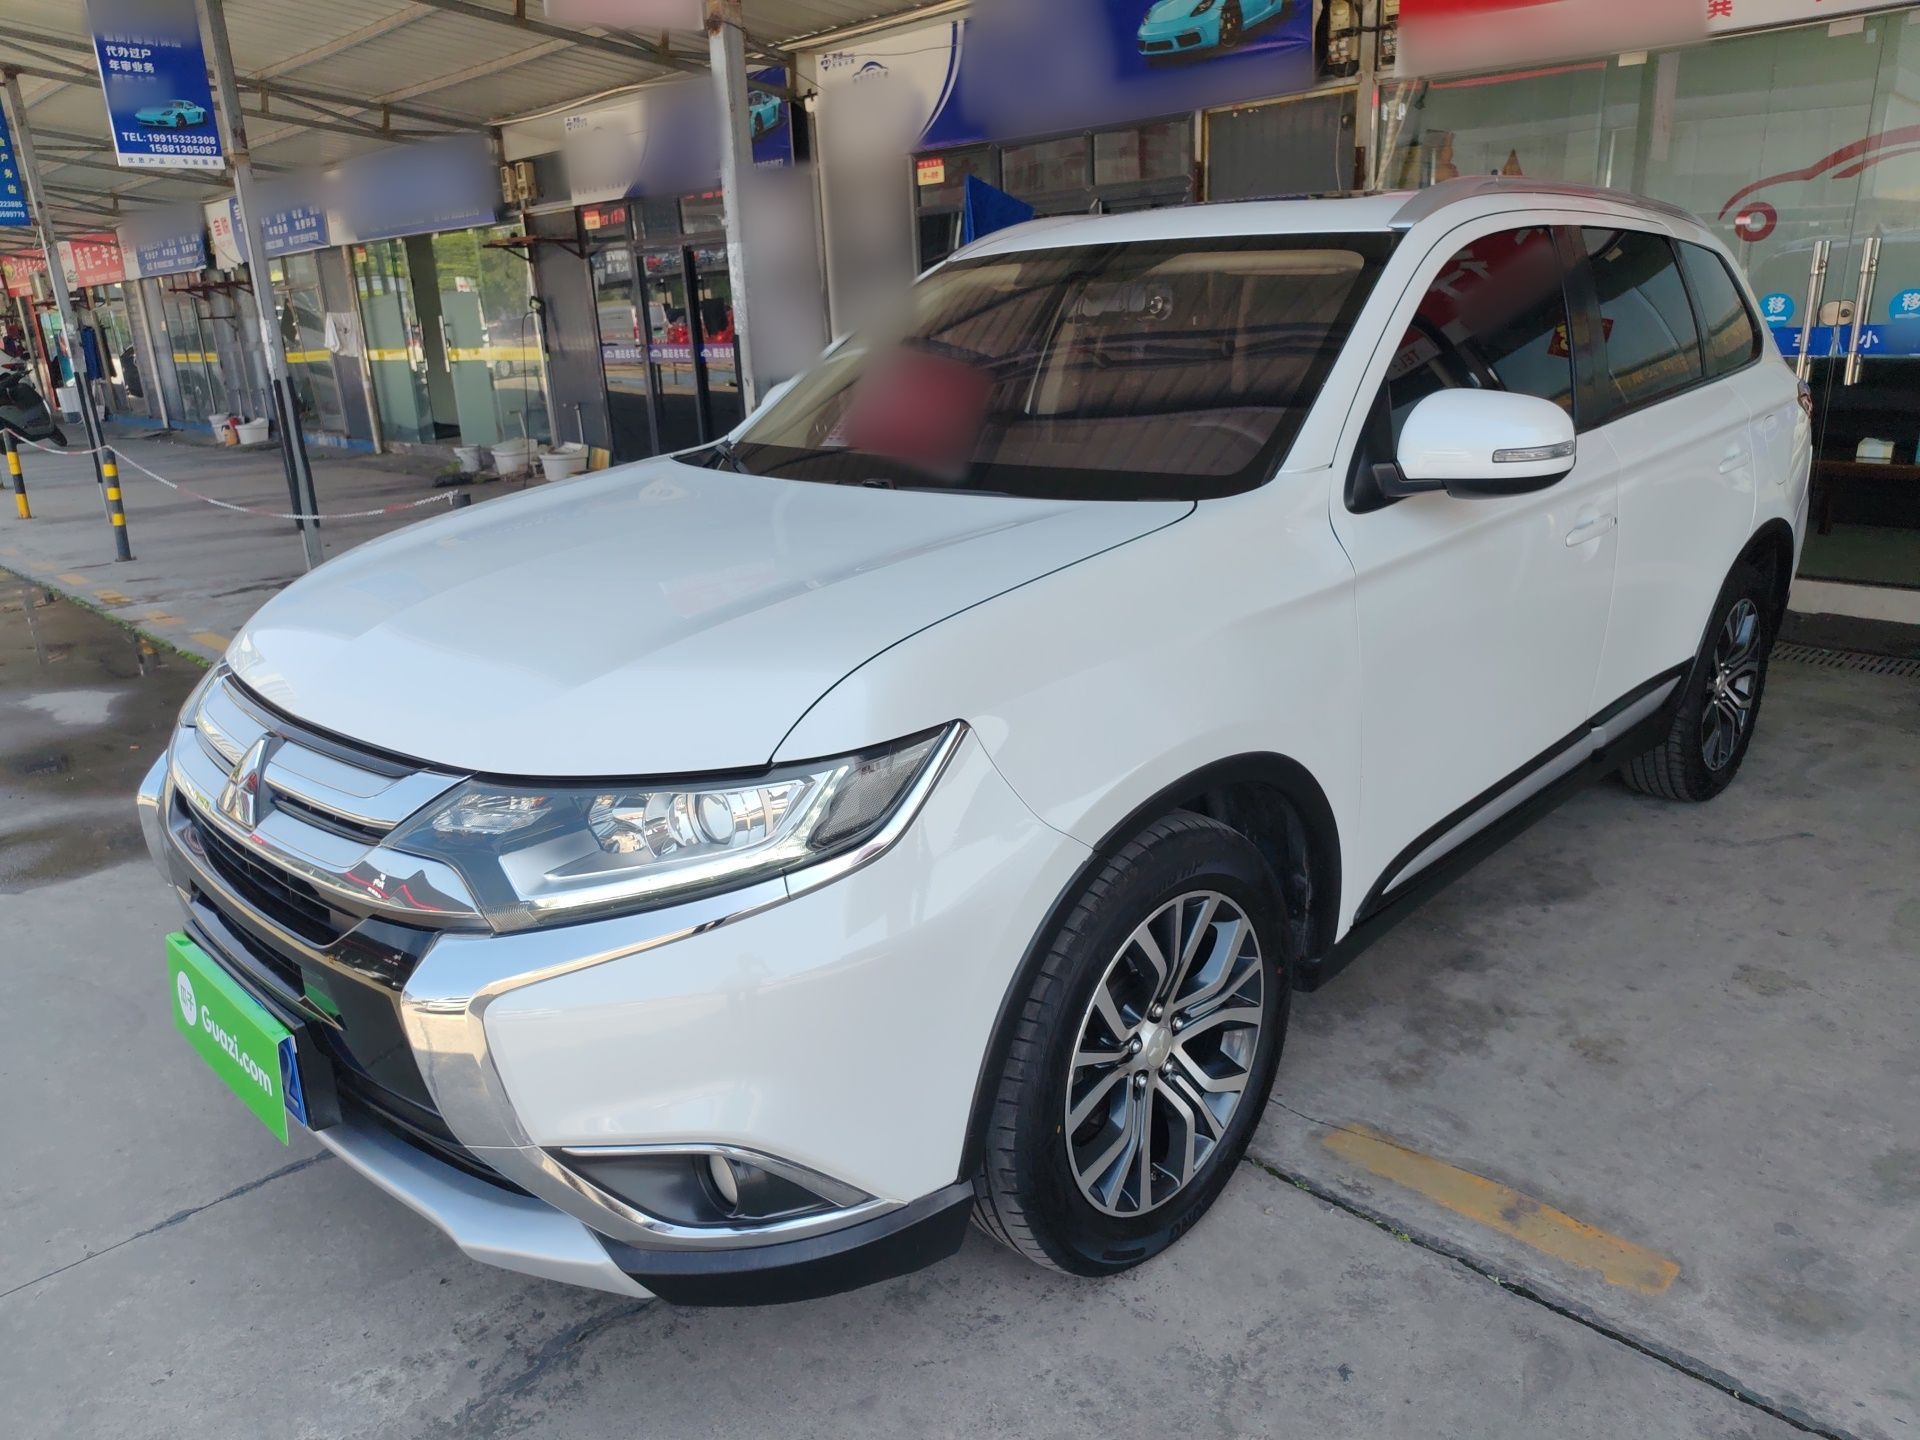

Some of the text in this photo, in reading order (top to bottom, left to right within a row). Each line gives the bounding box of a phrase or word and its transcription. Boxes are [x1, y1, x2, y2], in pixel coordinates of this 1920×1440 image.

[106, 45, 151, 59] 代办过户
[109, 59, 155, 73] 年审业务
[149, 144, 217, 154] 15881305087
[1768, 297, 1785, 314] 移
[1902, 292, 1920, 311] 移
[1859, 330, 1879, 349] 小
[201, 1005, 272, 1097] Guazi.com
